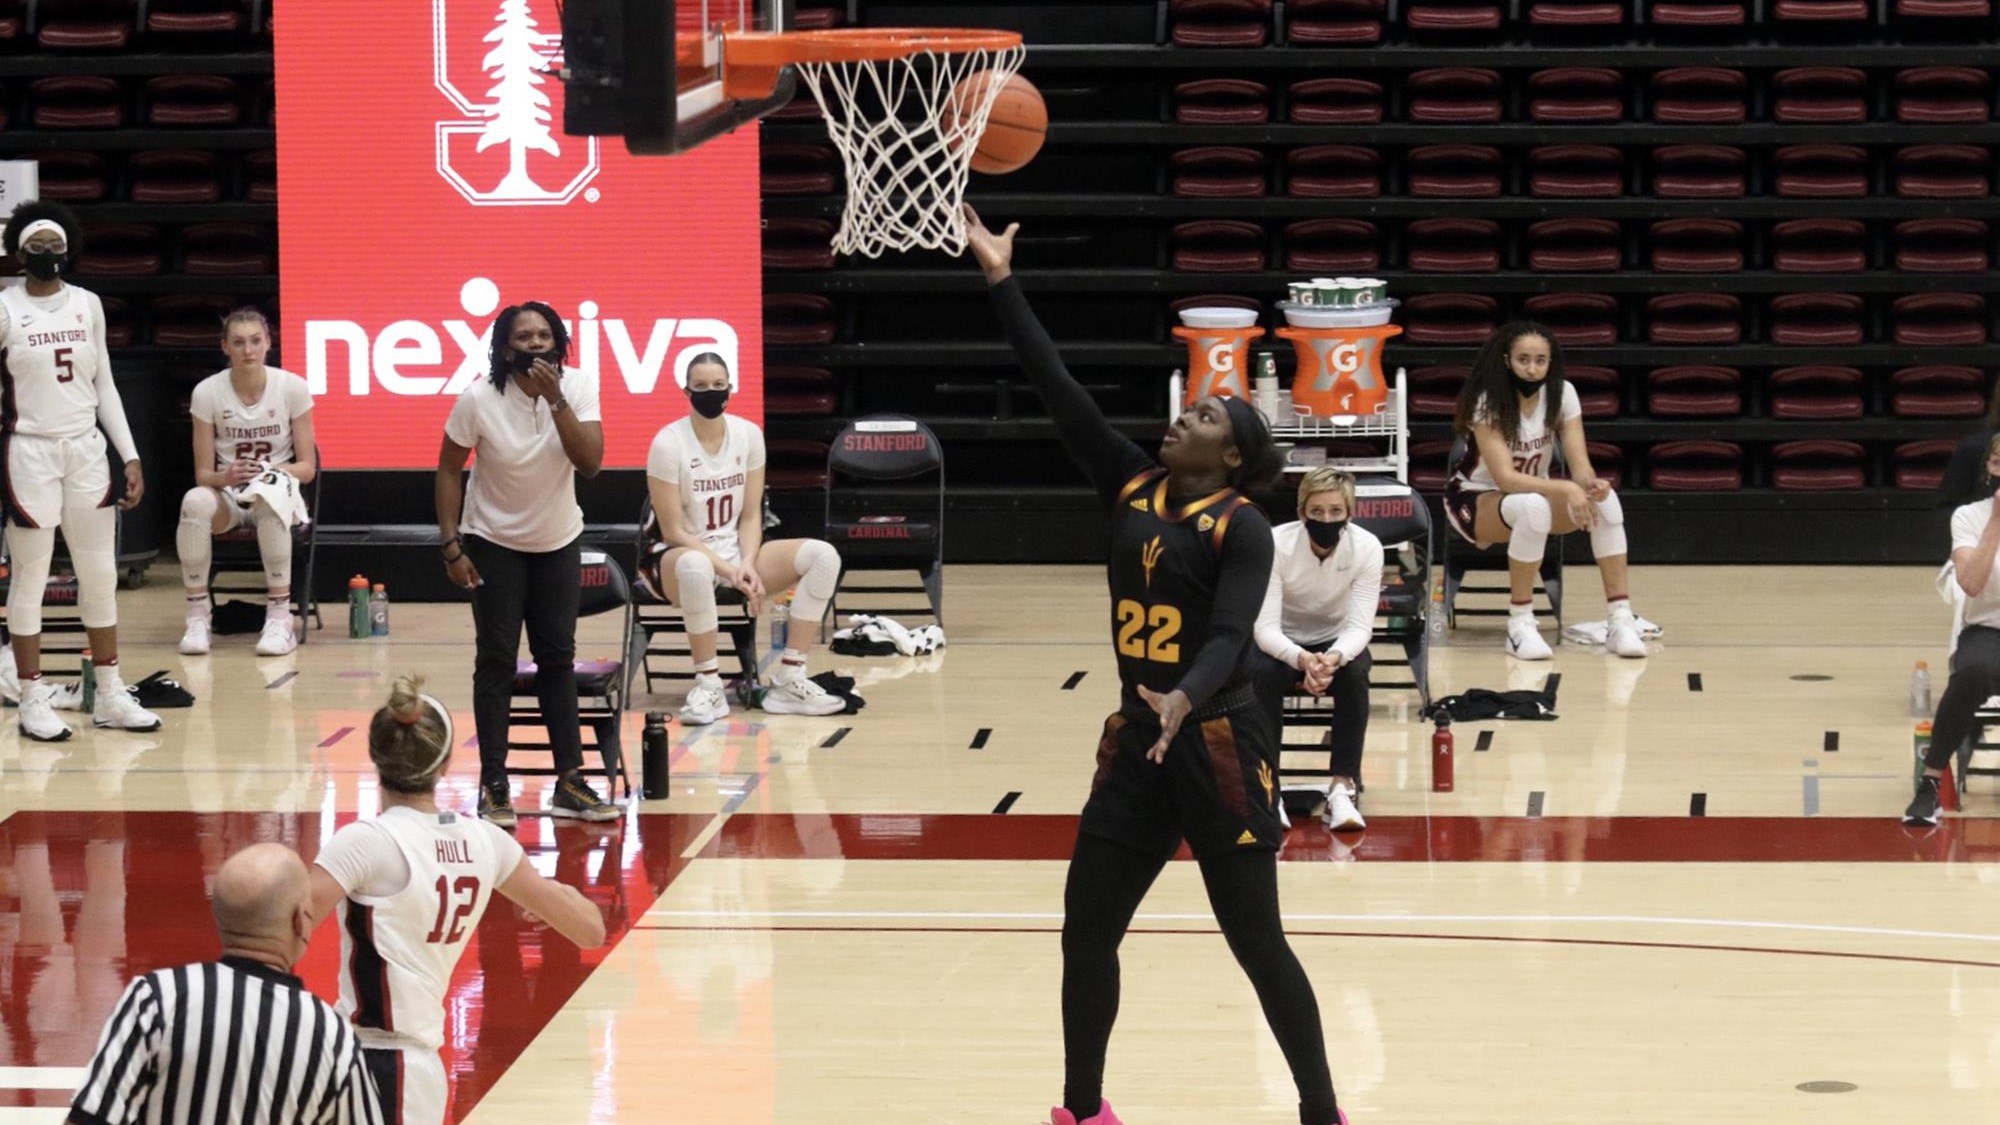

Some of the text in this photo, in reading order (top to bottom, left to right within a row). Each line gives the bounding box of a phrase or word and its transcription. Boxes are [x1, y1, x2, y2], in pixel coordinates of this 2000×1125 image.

[28, 329, 87, 347] STANFORD
[305, 277, 738, 395] nexiva
[54, 348, 74, 383] 5
[1208, 343, 1233, 373] G
[1332, 344, 1358, 373] G
[224, 424, 281, 439] STANFORD
[844, 433, 927, 451] STANFORD
[693, 473, 744, 492] STANFORD
[706, 494, 733, 531] 10
[848, 527, 910, 538] CARDINAL
[1117, 599, 1182, 663] 22
[435, 840, 473, 863] HULL
[426, 875, 480, 944] 12
